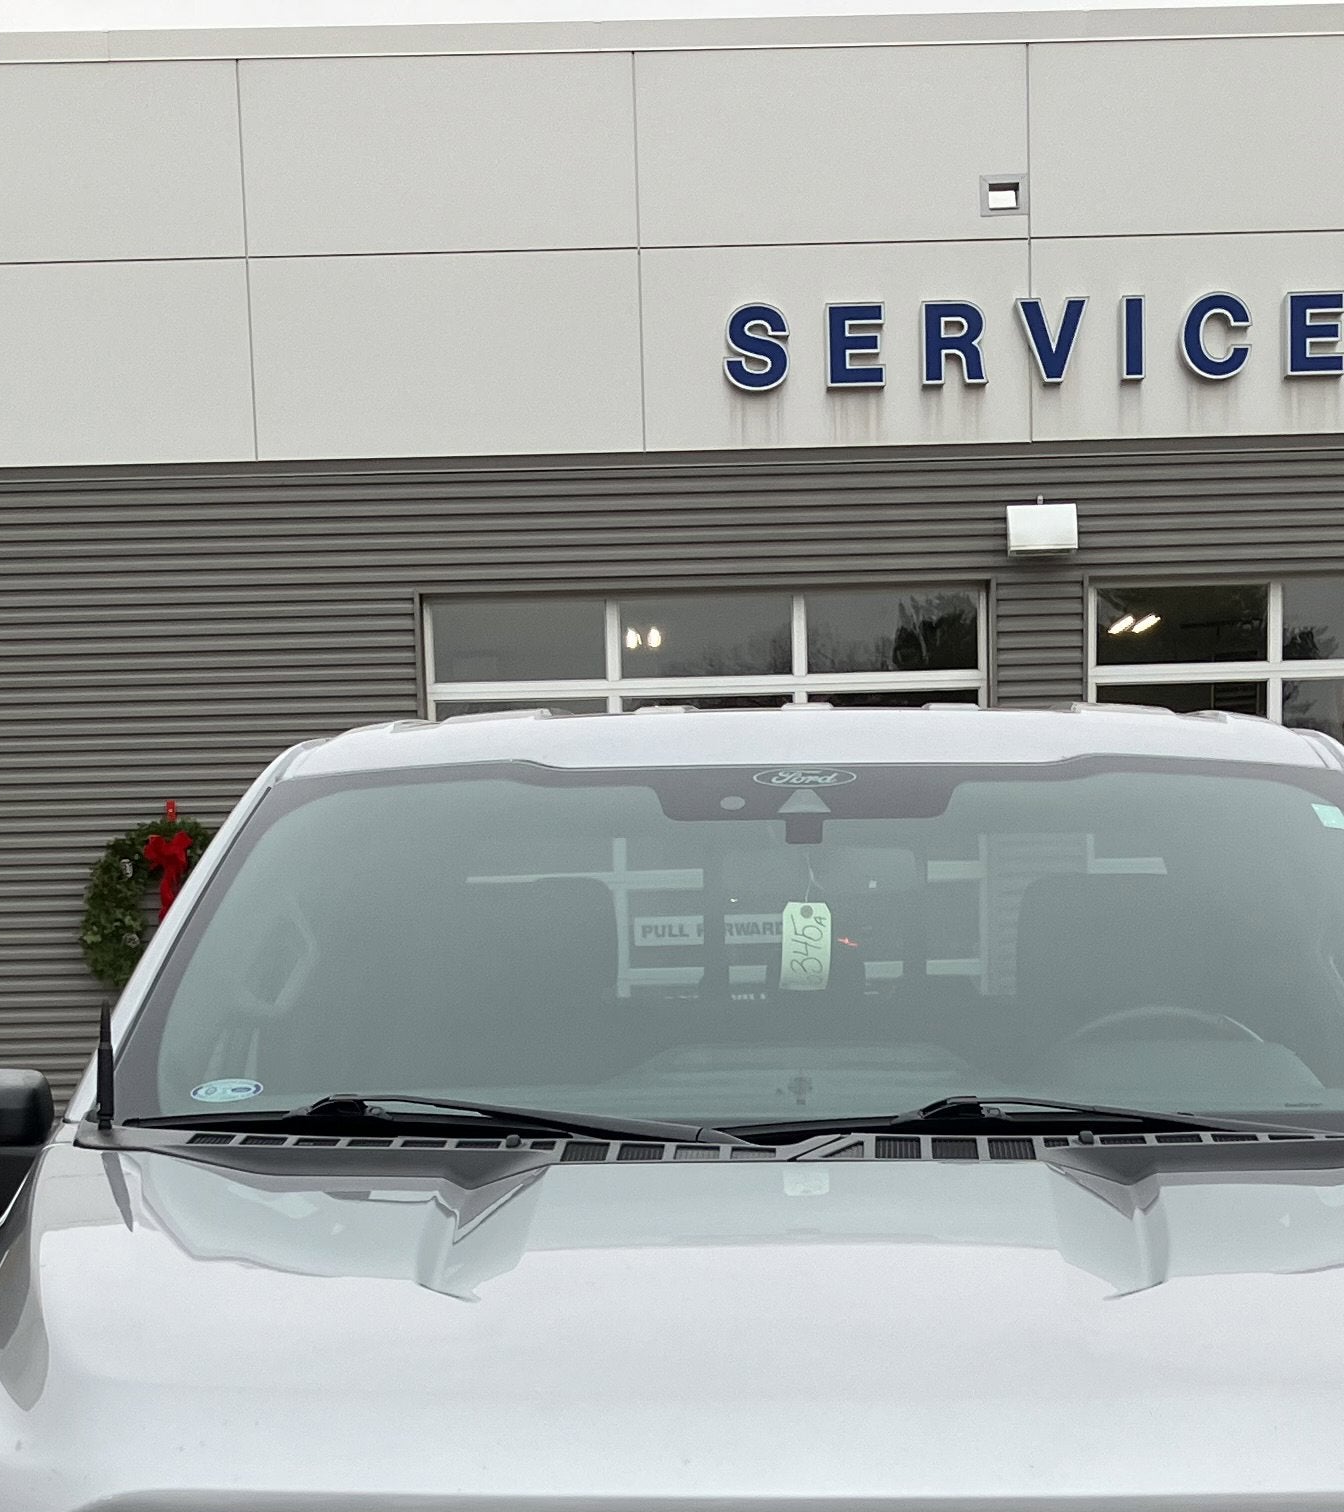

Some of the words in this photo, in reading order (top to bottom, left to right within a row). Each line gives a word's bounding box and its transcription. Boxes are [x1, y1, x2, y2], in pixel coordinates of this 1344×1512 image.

[771, 769, 839, 785] Ford
[641, 924, 690, 938] PULL
[698, 921, 783, 937] FRWARD
